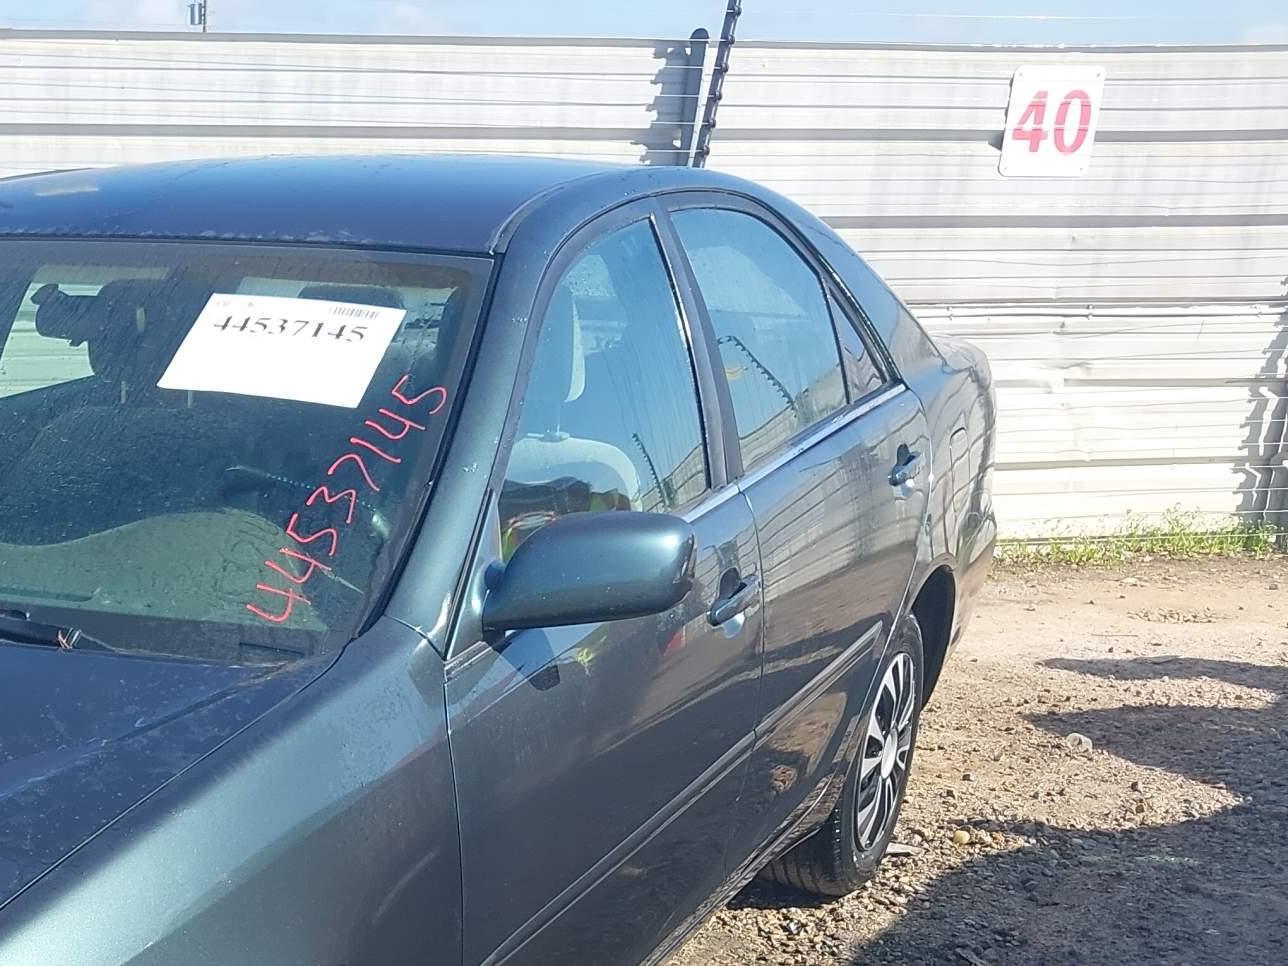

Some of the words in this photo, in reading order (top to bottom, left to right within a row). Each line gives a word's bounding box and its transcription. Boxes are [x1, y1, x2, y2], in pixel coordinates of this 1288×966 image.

[1011, 89, 1092, 156] 40
[213, 315, 369, 342] 44537145
[246, 374, 448, 622] 44537145
